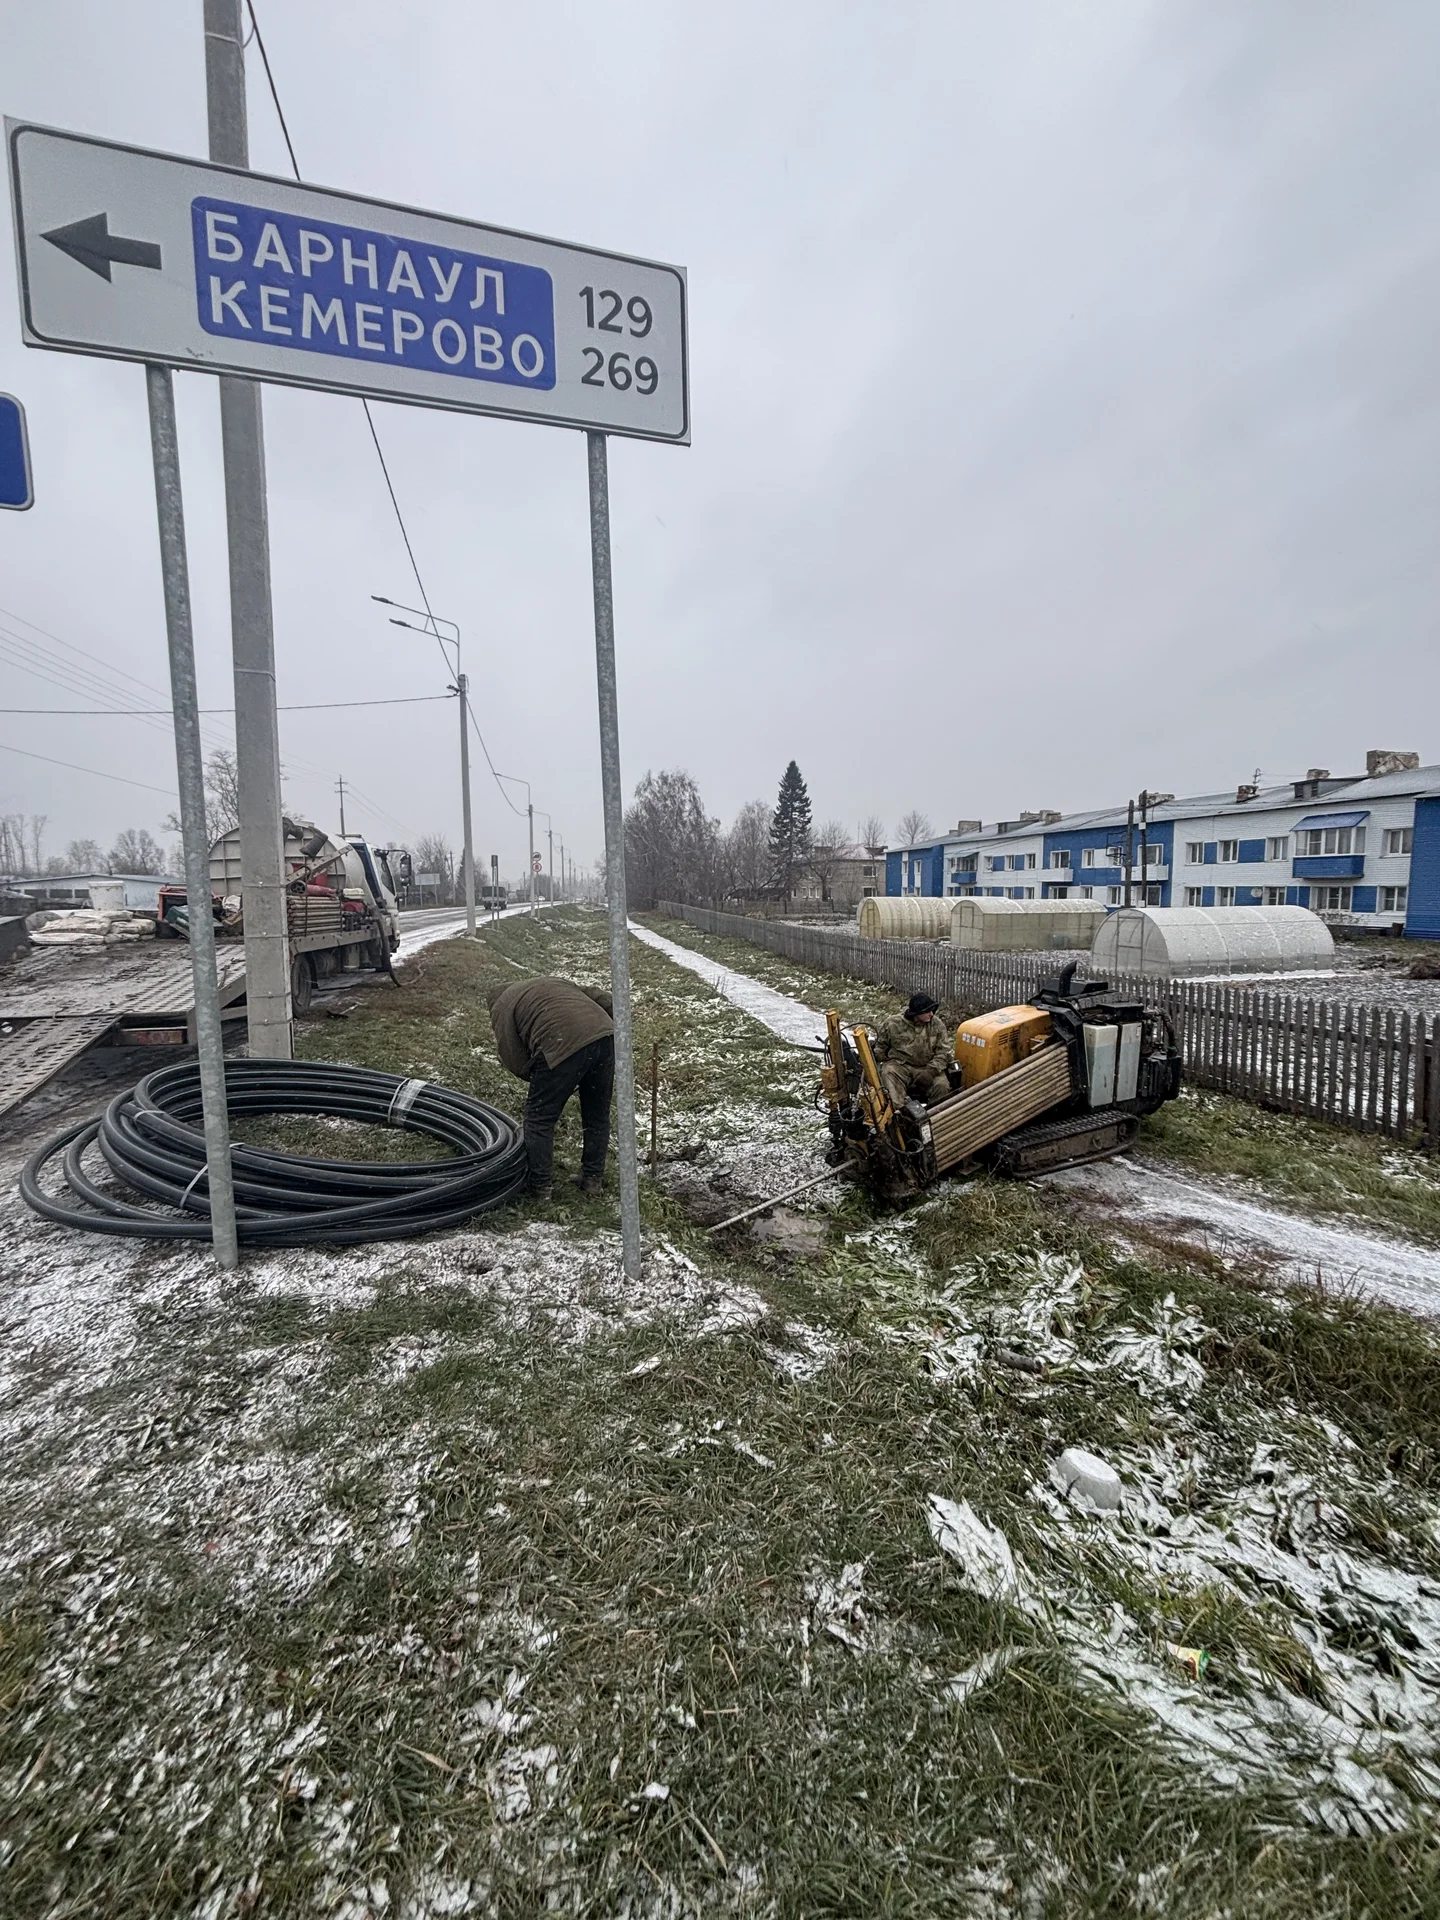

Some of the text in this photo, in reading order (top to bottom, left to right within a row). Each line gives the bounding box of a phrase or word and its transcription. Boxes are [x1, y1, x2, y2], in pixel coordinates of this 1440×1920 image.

[205, 211, 653, 338] БАРНАУЛ 129
[210, 276, 659, 395] КЕМЕРОВО 269
